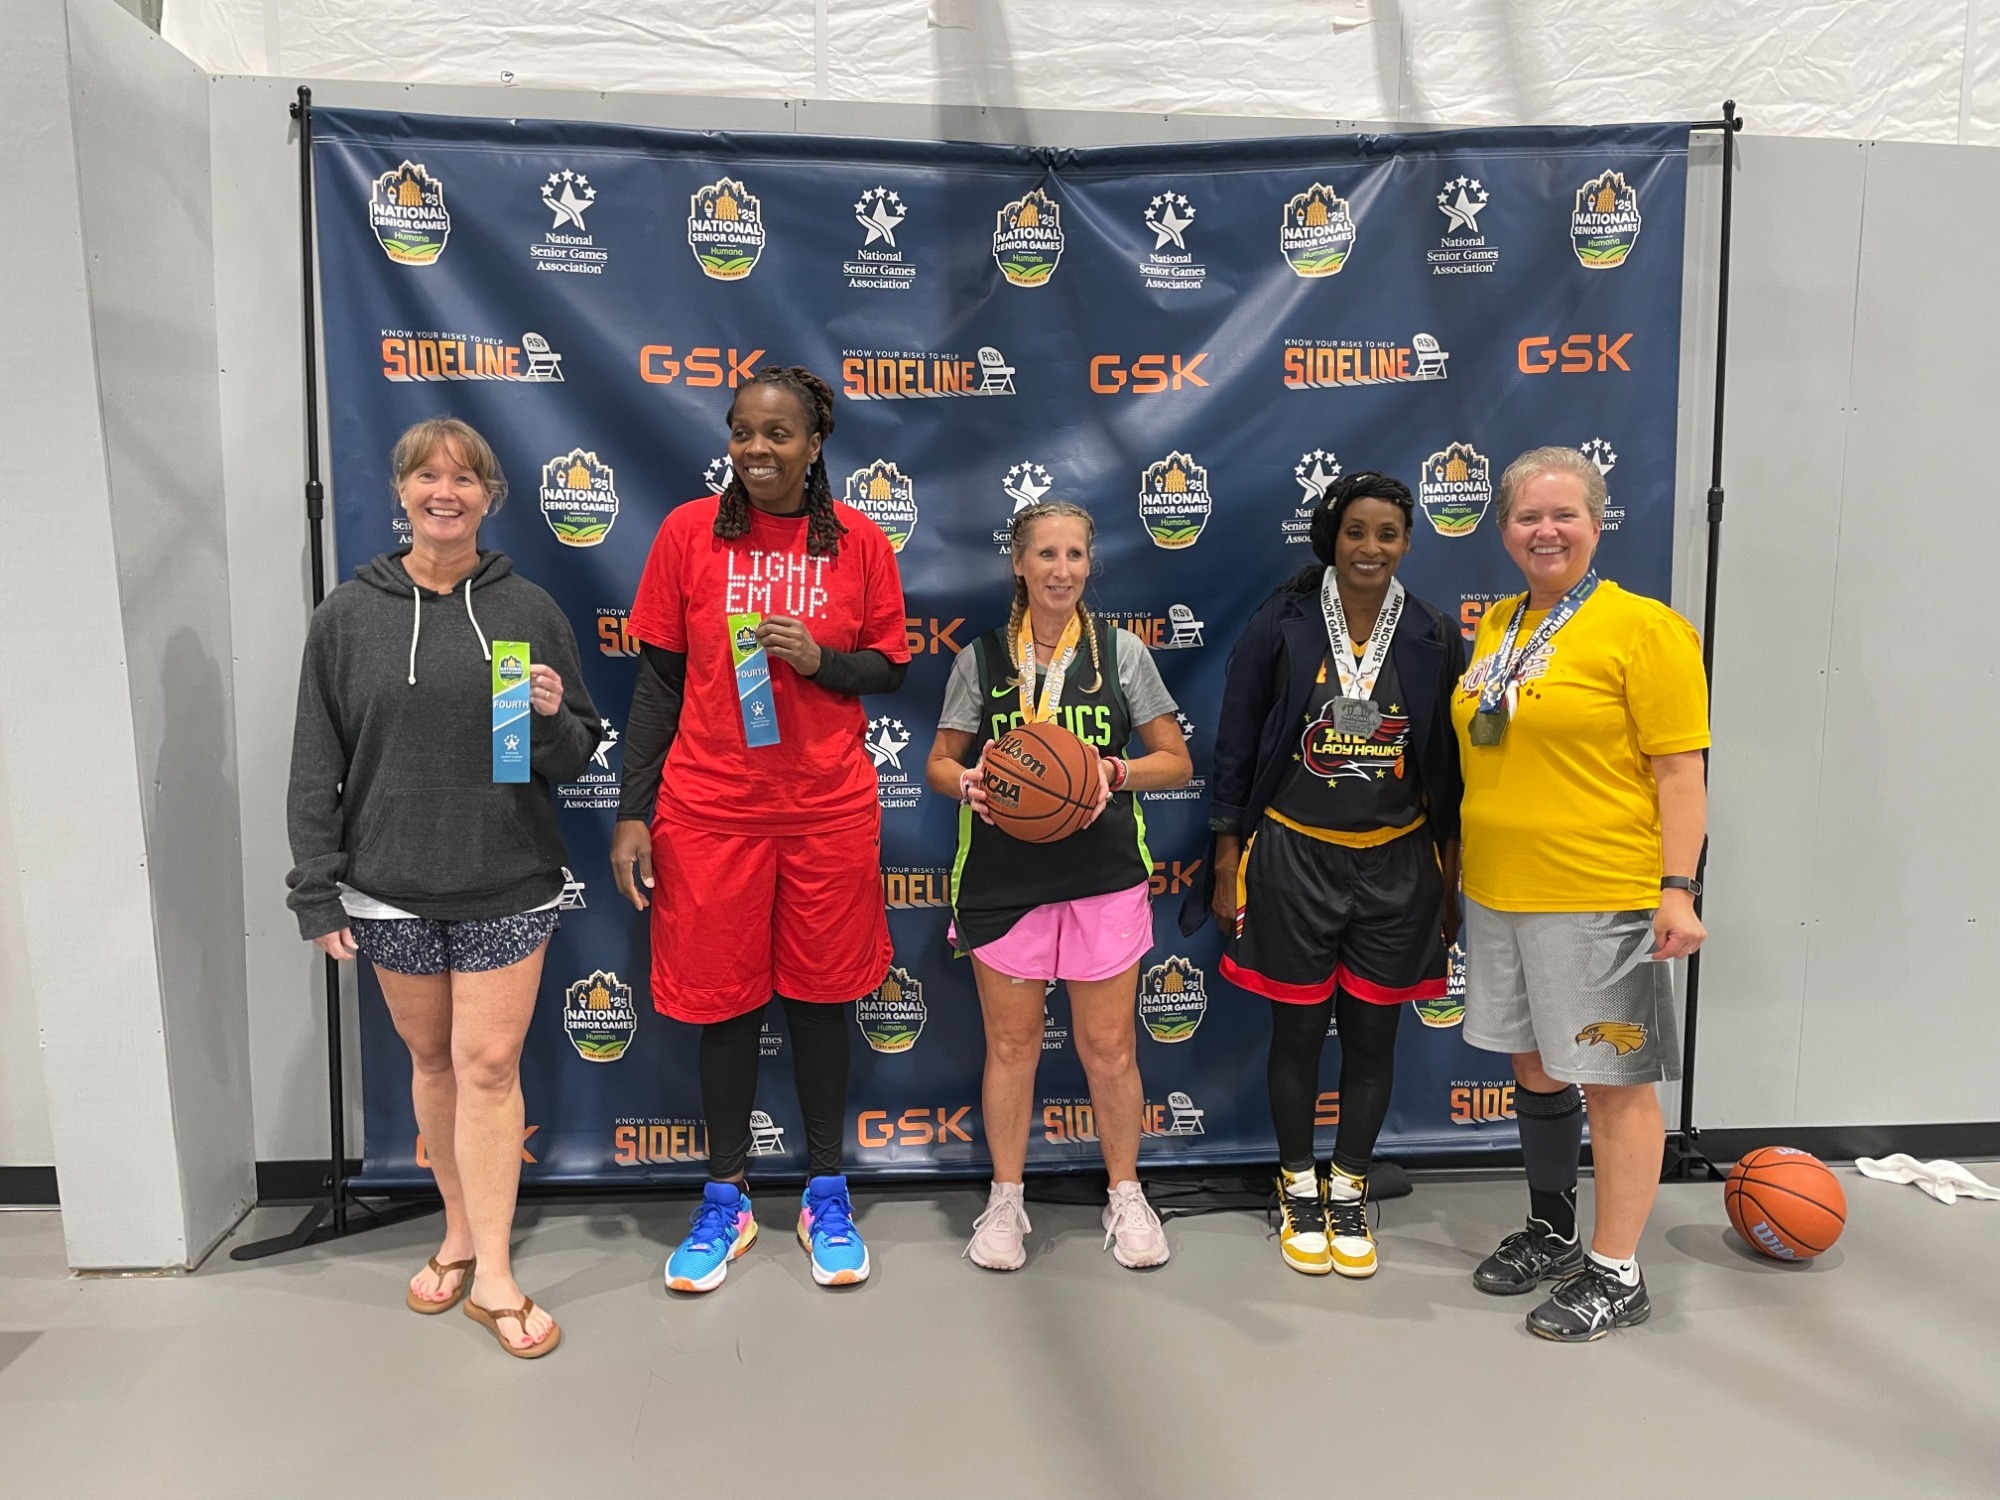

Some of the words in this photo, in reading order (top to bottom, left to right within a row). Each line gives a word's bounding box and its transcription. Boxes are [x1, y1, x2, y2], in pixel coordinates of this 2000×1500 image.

[374, 204, 446, 219] NATIONAL
[374, 216, 412, 228] SENIOR
[413, 220, 446, 230] GAMES
[1575, 212, 1637, 224] NATIONAL
[692, 220, 761, 235] NATIONAL
[1284, 223, 1352, 240] NATIONAL
[1574, 225, 1603, 235] SENIOR
[1604, 223, 1637, 234] GAMES
[394, 232, 429, 242] Humana
[545, 233, 592, 245] National
[692, 232, 726, 242] SENIOR
[728, 234, 761, 245] GAMES
[998, 228, 1060, 244] NATIONAL
[1284, 239, 1318, 250] SENIOR
[1319, 232, 1352, 245] GAMES
[1441, 236, 1484, 248] National
[996, 241, 1028, 252] SENIOR
[1029, 240, 1060, 250] GAMES
[1588, 238, 1620, 247] Humana
[530, 246, 567, 258] Senior
[570, 249, 608, 260] Games
[710, 247, 743, 256] Humana
[857, 250, 902, 261] National
[1303, 248, 1335, 259] Humana
[1427, 251, 1460, 262] Senior
[1462, 249, 1498, 260] Games
[1013, 254, 1043, 263] Humana
[1150, 254, 1192, 264] National
[536, 261, 602, 274] Association
[843, 263, 877, 275] Senior
[880, 265, 916, 276] Games
[1140, 265, 1169, 276] Senior
[1172, 267, 1206, 277] Games
[1433, 264, 1493, 275] Association
[848, 278, 909, 289] Association
[1145, 279, 1201, 289] Association
[381, 329, 413, 338] KNOW
[416, 331, 439, 339] YOUR
[442, 332, 467, 341] RISKS
[470, 335, 481, 343] TO
[483, 337, 503, 345] HELP
[526, 336, 545, 349] RSV
[1284, 338, 1313, 347] KNOW
[1316, 339, 1338, 347] YOUR
[1341, 340, 1362, 348] RISKS
[1417, 337, 1436, 348] RSV
[382, 339, 522, 378] SIDELINE
[842, 349, 872, 358] KNOW
[903, 351, 926, 359] RISKS
[982, 351, 1000, 362] RSV
[1518, 333, 1633, 374] GSK
[640, 344, 766, 388] GSK
[1284, 348, 1411, 384] SIDELINE
[842, 358, 975, 394] SIDELINE
[1090, 353, 1210, 394] GSK
[1423, 481, 1488, 494] NATIONAL
[543, 488, 615, 503] NATIONAL
[1143, 492, 1208, 505] NATIONAL
[1423, 494, 1457, 504] SENIOR
[1458, 493, 1488, 502] GAMES
[544, 501, 580, 511] SENIOR
[581, 503, 615, 512] GAMES
[847, 500, 913, 512] NATIONAL
[1143, 506, 1176, 515] SENIOR
[1177, 504, 1208, 514] GAMES
[1442, 506, 1472, 514] Humana
[563, 515, 596, 524] Humana
[882, 513, 914, 521] GAMES
[1161, 518, 1191, 526] Humana
[1281, 522, 1312, 531] Senior
[728, 550, 829, 586] LIGHT
[726, 582, 771, 614] EM
[1322, 586, 1335, 618] SENIOR
[596, 608, 626, 616] KNOW
[1172, 608, 1190, 617] RSV
[1333, 598, 1347, 635] NATIONAL
[1371, 608, 1389, 642] NATIONAL
[1373, 628, 1393, 662] SENIOR
[1387, 594, 1403, 626] GAMES
[1543, 607, 1574, 640] GAMES
[906, 618, 966, 654] SK
[1328, 618, 1344, 655] GAMES
[1526, 617, 1552, 650] NATIONAL
[1058, 646, 1073, 676] GAMES
[737, 667, 768, 679] FOURTH
[494, 700, 529, 709] FOURTH
[992, 705, 1110, 746] CICS
[1313, 743, 1353, 755] LADY
[1354, 745, 1403, 757] HAWKS
[577, 772, 616, 783] ational
[878, 773, 908, 782] tional
[557, 787, 591, 796] Senior
[594, 786, 620, 795] Gam
[888, 786, 922, 795] Games
[1143, 792, 1200, 800] Association
[564, 799, 620, 808] Associatio
[1143, 992, 1203, 1005] NATIONAL
[860, 1002, 923, 1012] NATIONAL
[1143, 1004, 1173, 1013] SENIOR
[1174, 1002, 1204, 1011] GAMES
[568, 1009, 632, 1021] NATIONAL
[860, 1012, 892, 1020] SENIOR
[568, 1020, 600, 1029] SENIOR
[601, 1021, 633, 1029] GAMES
[751, 1115, 769, 1124] RSV
[858, 1106, 974, 1148] GSK
